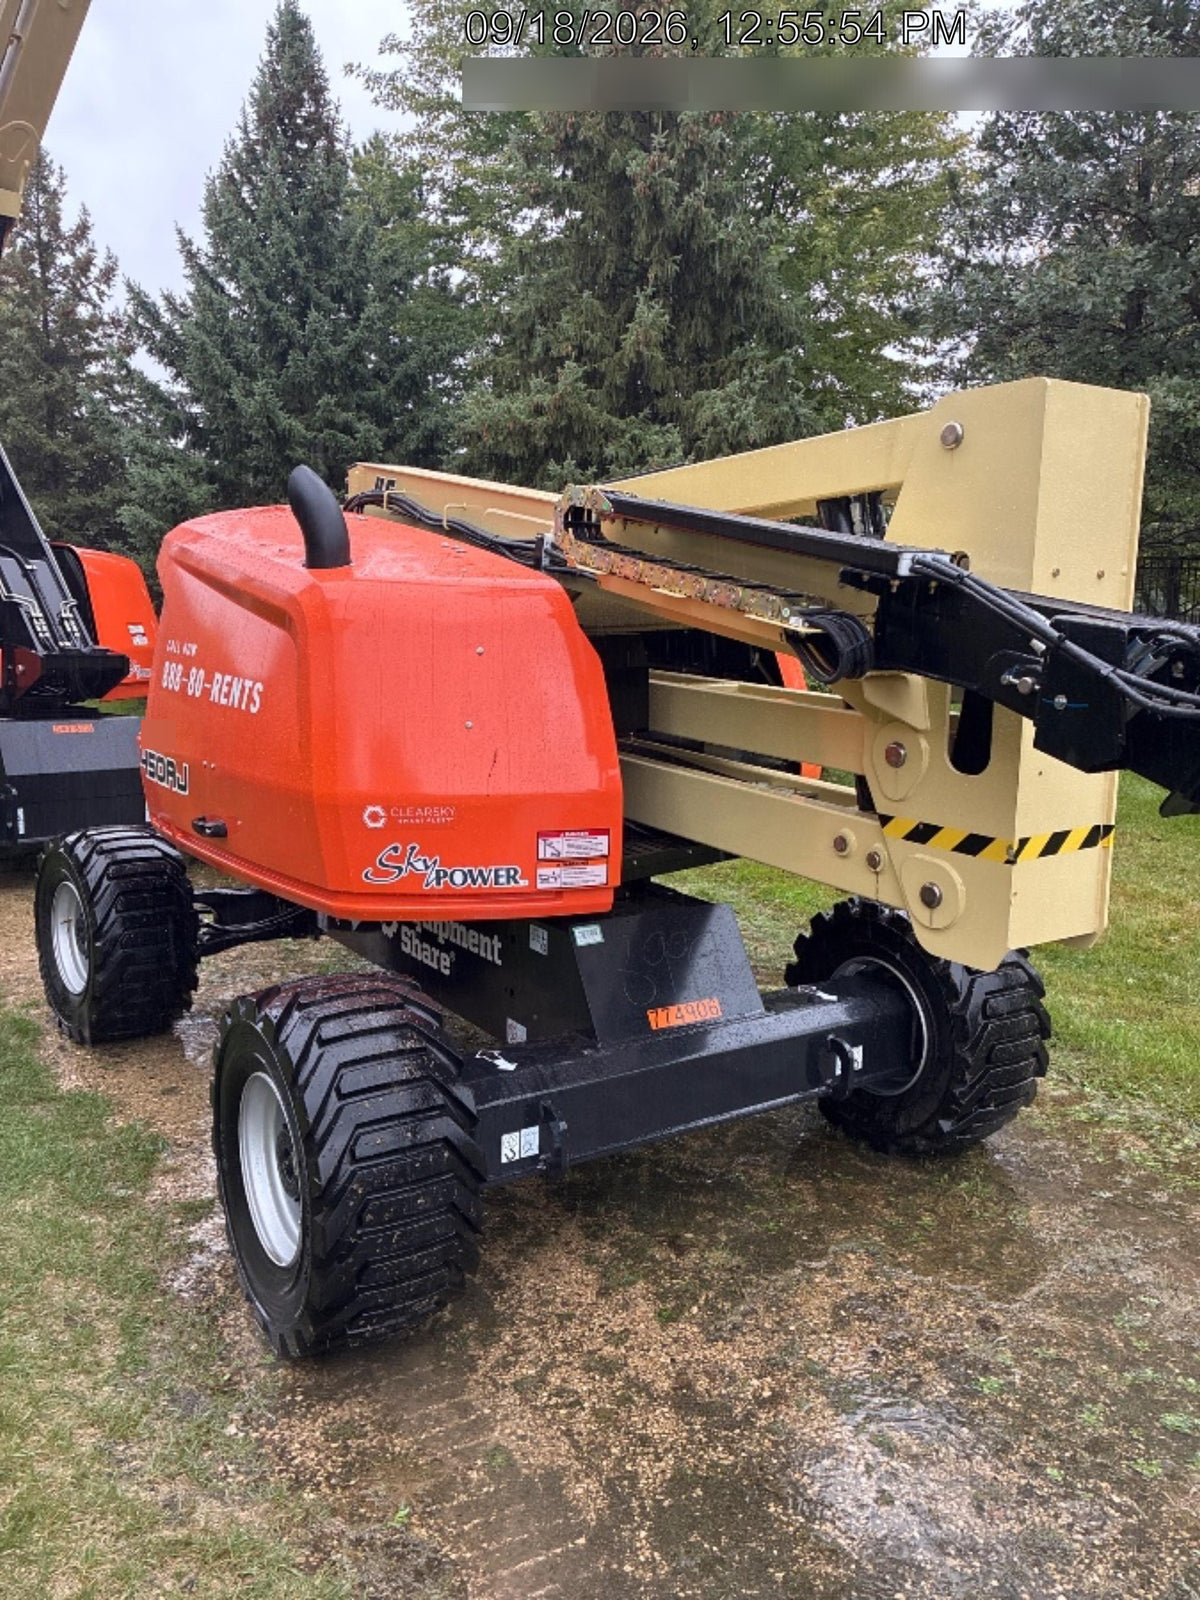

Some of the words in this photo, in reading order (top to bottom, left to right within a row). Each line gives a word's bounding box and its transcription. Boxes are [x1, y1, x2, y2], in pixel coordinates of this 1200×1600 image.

[162, 661, 264, 713] 888-80-RENTS
[390, 806, 456, 817] CLEARSKY
[362, 842, 441, 890] Sky
[433, 865, 522, 888] POWER
